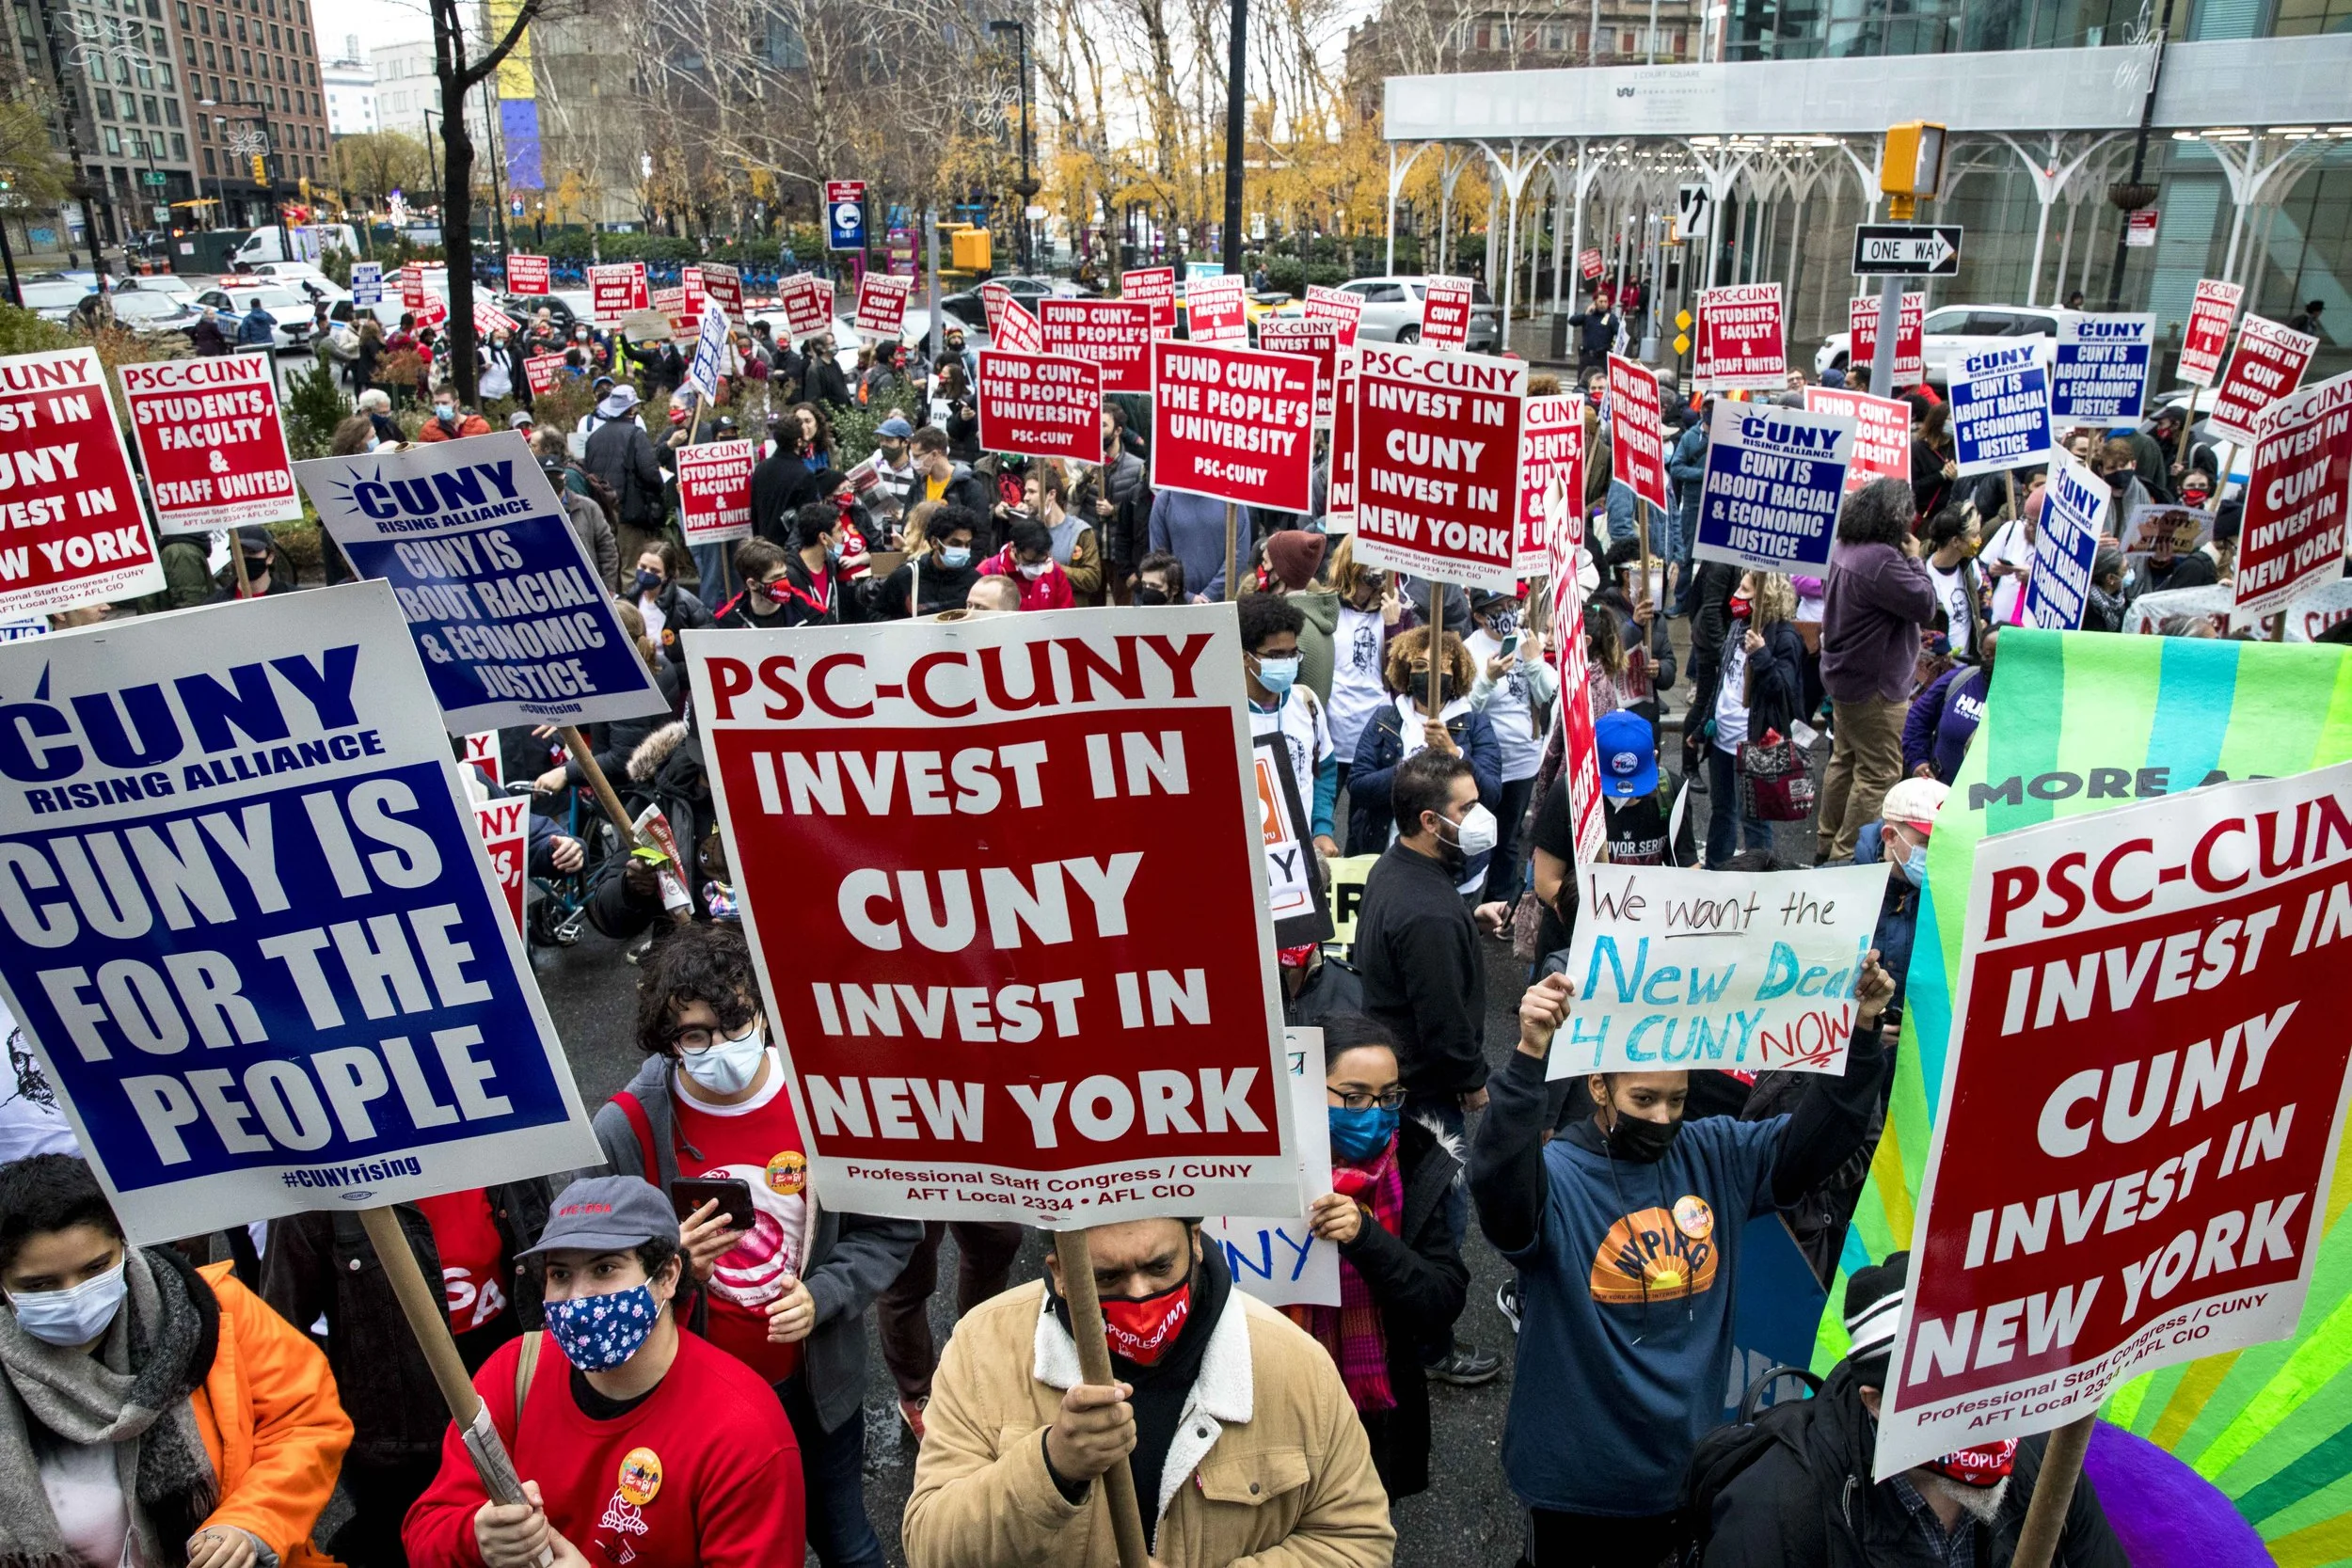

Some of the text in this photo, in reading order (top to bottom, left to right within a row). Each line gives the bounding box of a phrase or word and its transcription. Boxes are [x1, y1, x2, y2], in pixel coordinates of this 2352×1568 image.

[1870, 241, 1945, 260] ONE WAY
[865, 283, 904, 297] INVEST IN
[1187, 277, 1241, 291] PSC-CUNY
[1188, 290, 1243, 307] STUDENTS,
[1708, 285, 1778, 303] PSC-CUNY
[862, 307, 899, 320] INVEST IN
[867, 295, 898, 309] CUNY
[1047, 307, 1087, 323] FUND
[1196, 302, 1237, 317] FACULTY
[1711, 306, 1779, 324] STUDENTS,
[857, 317, 900, 331] NEW YORK
[1043, 325, 1070, 340] THE
[1192, 326, 1246, 341] STAFF UNITED
[1721, 324, 1772, 340] FACULTY
[2077, 323, 2146, 338] CUNY
[986, 358, 1031, 379] FUND
[1165, 355, 1221, 384] FUND
[1714, 356, 1783, 373] STAFF UNITED
[1965, 345, 2035, 372] CUNY
[2076, 345, 2127, 362] CUNY IS
[124, 358, 262, 389] PSC-CUNY
[1362, 348, 1520, 393] PSC-CUNY
[1971, 373, 2023, 401] CUNY IS
[2056, 364, 2143, 379] ABOUT RACIAL
[982, 379, 1098, 408] THE PEOPLE'S
[1160, 384, 1309, 427] THE PEOPLE'S
[1369, 383, 1505, 427] INVEST IN
[1955, 389, 2046, 421] ABOUT RACIAL
[2070, 382, 2137, 397] ECONOMIC
[136, 390, 272, 424] STUDENTS,
[991, 401, 1091, 426] UNIVERSITY
[2070, 399, 2121, 415] JUSTICE
[158, 419, 262, 450] FACULTY
[1011, 429, 1073, 446] PSC-CUNY
[1170, 414, 1296, 457] UNIVERSITY
[1741, 417, 1842, 450] CUNY
[1975, 413, 2042, 439] ECONOMIC
[2257, 410, 2350, 469] INVEST IN
[209, 451, 230, 473] &
[679, 443, 749, 461] PSC-CUNY
[1386, 428, 1486, 474] CUNY
[1742, 438, 1835, 459] RISING ALLIANCE
[1978, 433, 2029, 459] JUSTICE
[682, 461, 752, 482] STUDENTS,
[1194, 456, 1267, 486] PSC-CUNY
[1740, 451, 1812, 483] CUNY IS
[2266, 455, 2332, 510] CUNY
[156, 469, 290, 505] STAFF UNITED
[353, 460, 522, 520] CUNY
[691, 477, 746, 497] FACULTY
[1370, 467, 1499, 513] INVEST IN
[1708, 471, 1835, 514] ABOUT RACIAL
[375, 499, 533, 533] RISING ALLIANCE
[687, 513, 717, 529] STAFF
[1359, 505, 1509, 560] NEW YORK
[1729, 502, 1824, 537] ECONOMIC
[2250, 508, 2314, 552] INVEST
[2317, 493, 2338, 518] IN
[395, 530, 523, 579] CUNY IS
[1727, 528, 1800, 559] JUSTICE
[2238, 525, 2344, 595] NEW YORK
[474, 566, 599, 619] RACIAL
[421, 611, 606, 663] & ECONOMIC
[473, 658, 596, 699] JUSTICE
[704, 633, 1216, 721] PSC-CUNY
[0, 644, 359, 782] CUNY
[24, 730, 385, 815] RISING ALLIANCE
[752, 731, 1189, 816] INVEST IN
[1968, 768, 2170, 811] MORE
[0, 779, 442, 948] CUNY IS
[836, 851, 1144, 953] CUNY
[1591, 873, 1835, 930] We want the
[1581, 934, 1869, 1006] New Deal
[2000, 881, 2352, 1037] INVEST IN
[37, 903, 493, 1062] FOR THE
[811, 968, 1211, 1042] INVEST IN
[1570, 1003, 1850, 1067] 4 CUNY NOW
[119, 1026, 514, 1165] PEOPLE
[2036, 1000, 2301, 1159] CUNY
[805, 1067, 1268, 1148] NEW YORK
[282, 1155, 421, 1188] #CUNYrising
[847, 1163, 1253, 1194] Professional Staff Congress CUNY
[1963, 1102, 2297, 1271] INVEST IN
[907, 1183, 1195, 1212] AFT Local 2334 AFL CIO
[1614, 1227, 1709, 1279] NYPIRG
[1907, 1192, 2308, 1387] NEW YORK
[1106, 1298, 1187, 1350] PEOPLESCUNY
[1916, 1292, 2269, 1427] Professional Staff Congress CUNY
